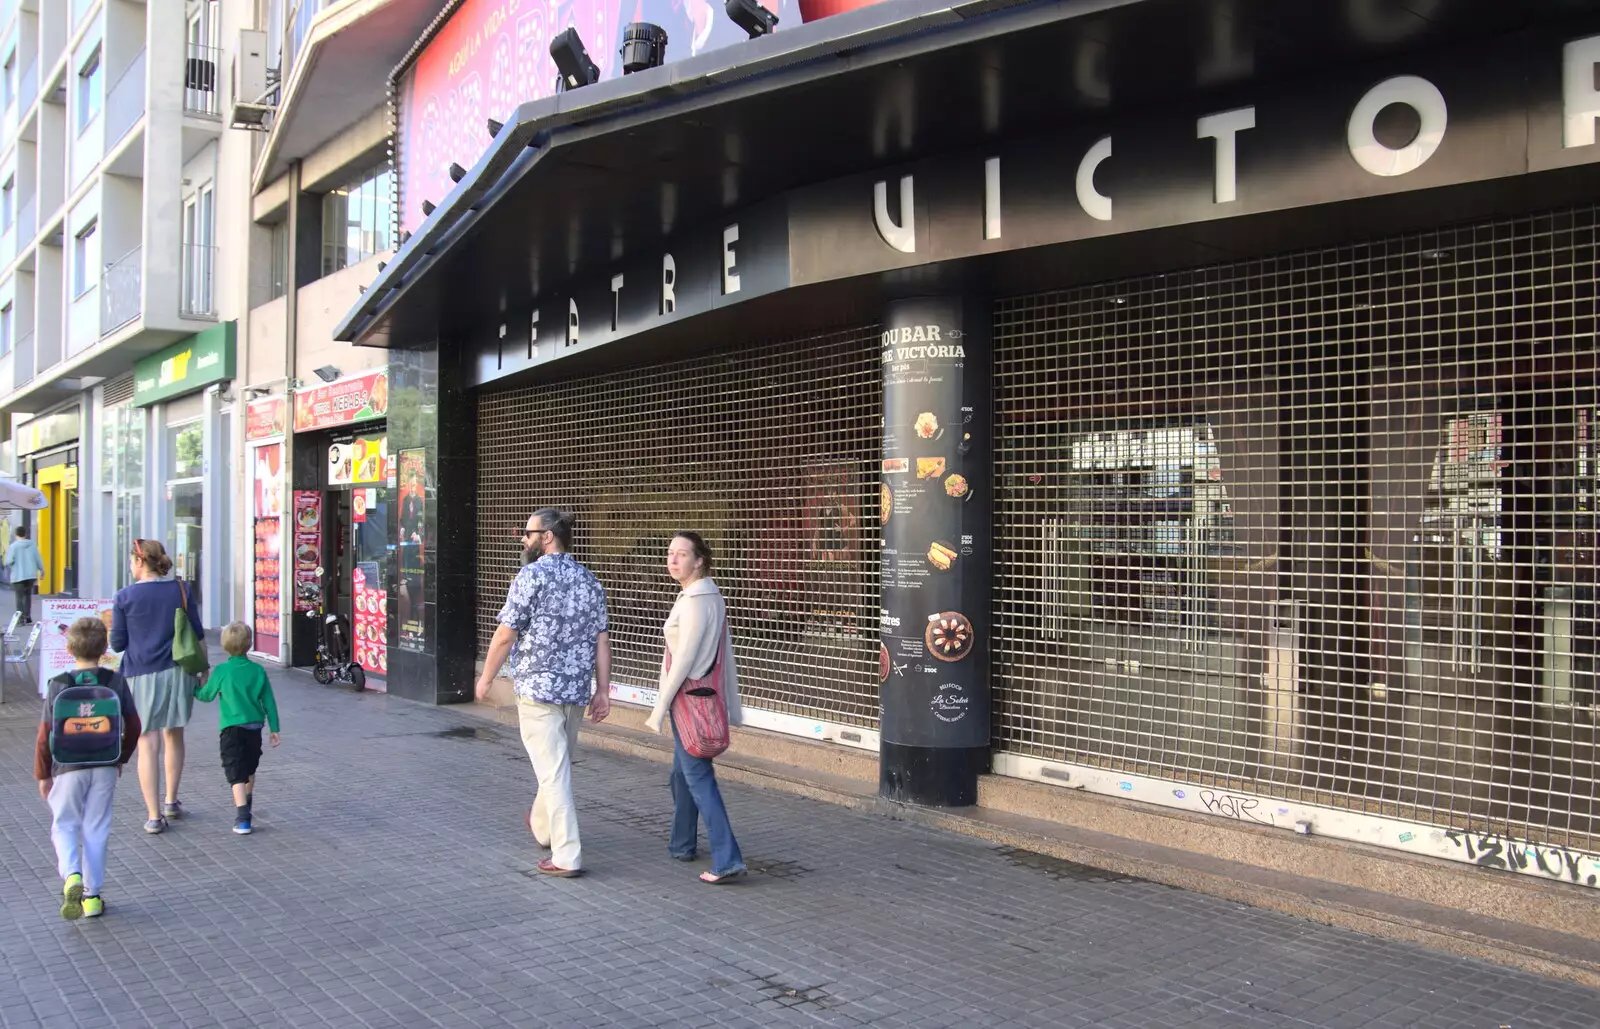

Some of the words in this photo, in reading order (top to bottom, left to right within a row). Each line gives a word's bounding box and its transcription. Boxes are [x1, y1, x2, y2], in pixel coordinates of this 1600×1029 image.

[483, 4, 507, 39] VIDA
[497, 222, 741, 371] TEATRE
[900, 325, 942, 344] BAR
[896, 343, 966, 361] VICTÒRIA
